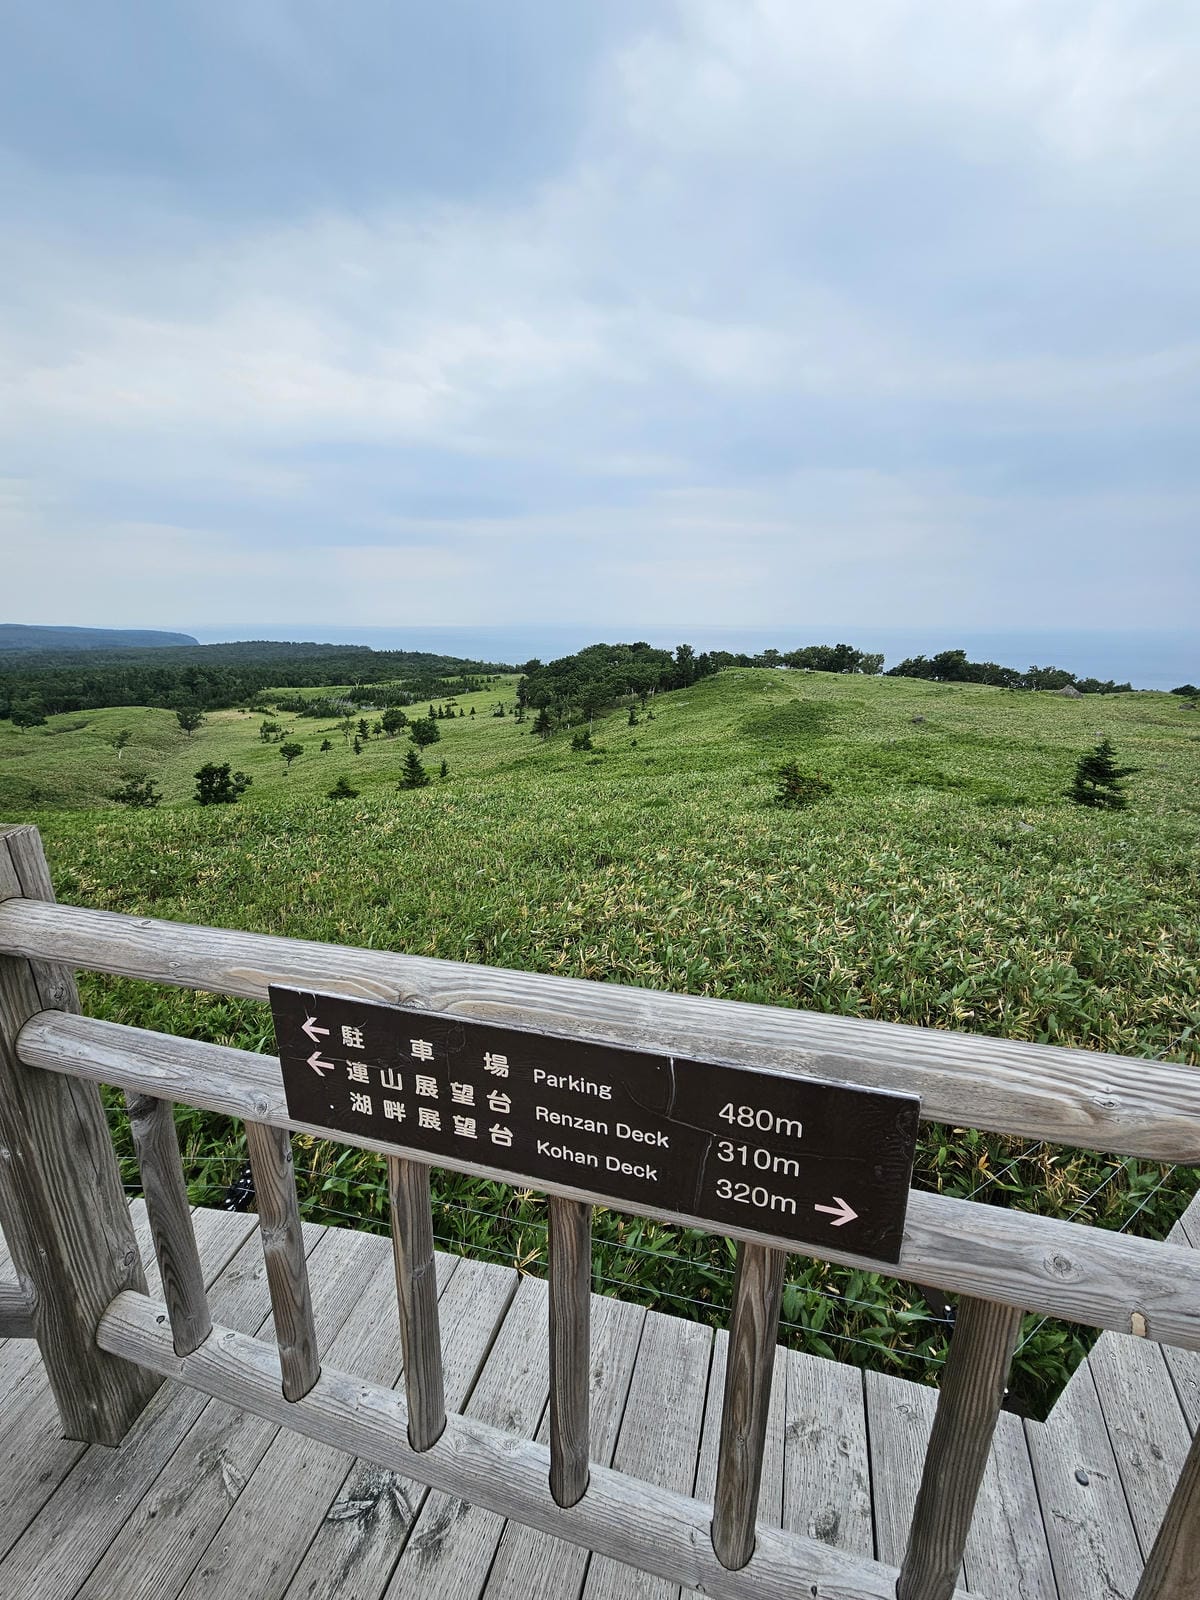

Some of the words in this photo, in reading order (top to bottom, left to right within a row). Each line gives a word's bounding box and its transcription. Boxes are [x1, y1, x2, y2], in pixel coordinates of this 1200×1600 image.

[341, 1025, 510, 1078] 駐車場
[346, 1059, 512, 1114] 連山展望台
[533, 1068, 612, 1100] Parking
[349, 1091, 514, 1147] 湖畔展望台
[536, 1106, 608, 1135] Renzan
[616, 1122, 670, 1148] Deck
[718, 1102, 804, 1138] 480m
[536, 1140, 598, 1168] Kohan
[605, 1155, 659, 1181] Deck
[717, 1141, 800, 1177] 310m
[716, 1178, 797, 1215] 320m
